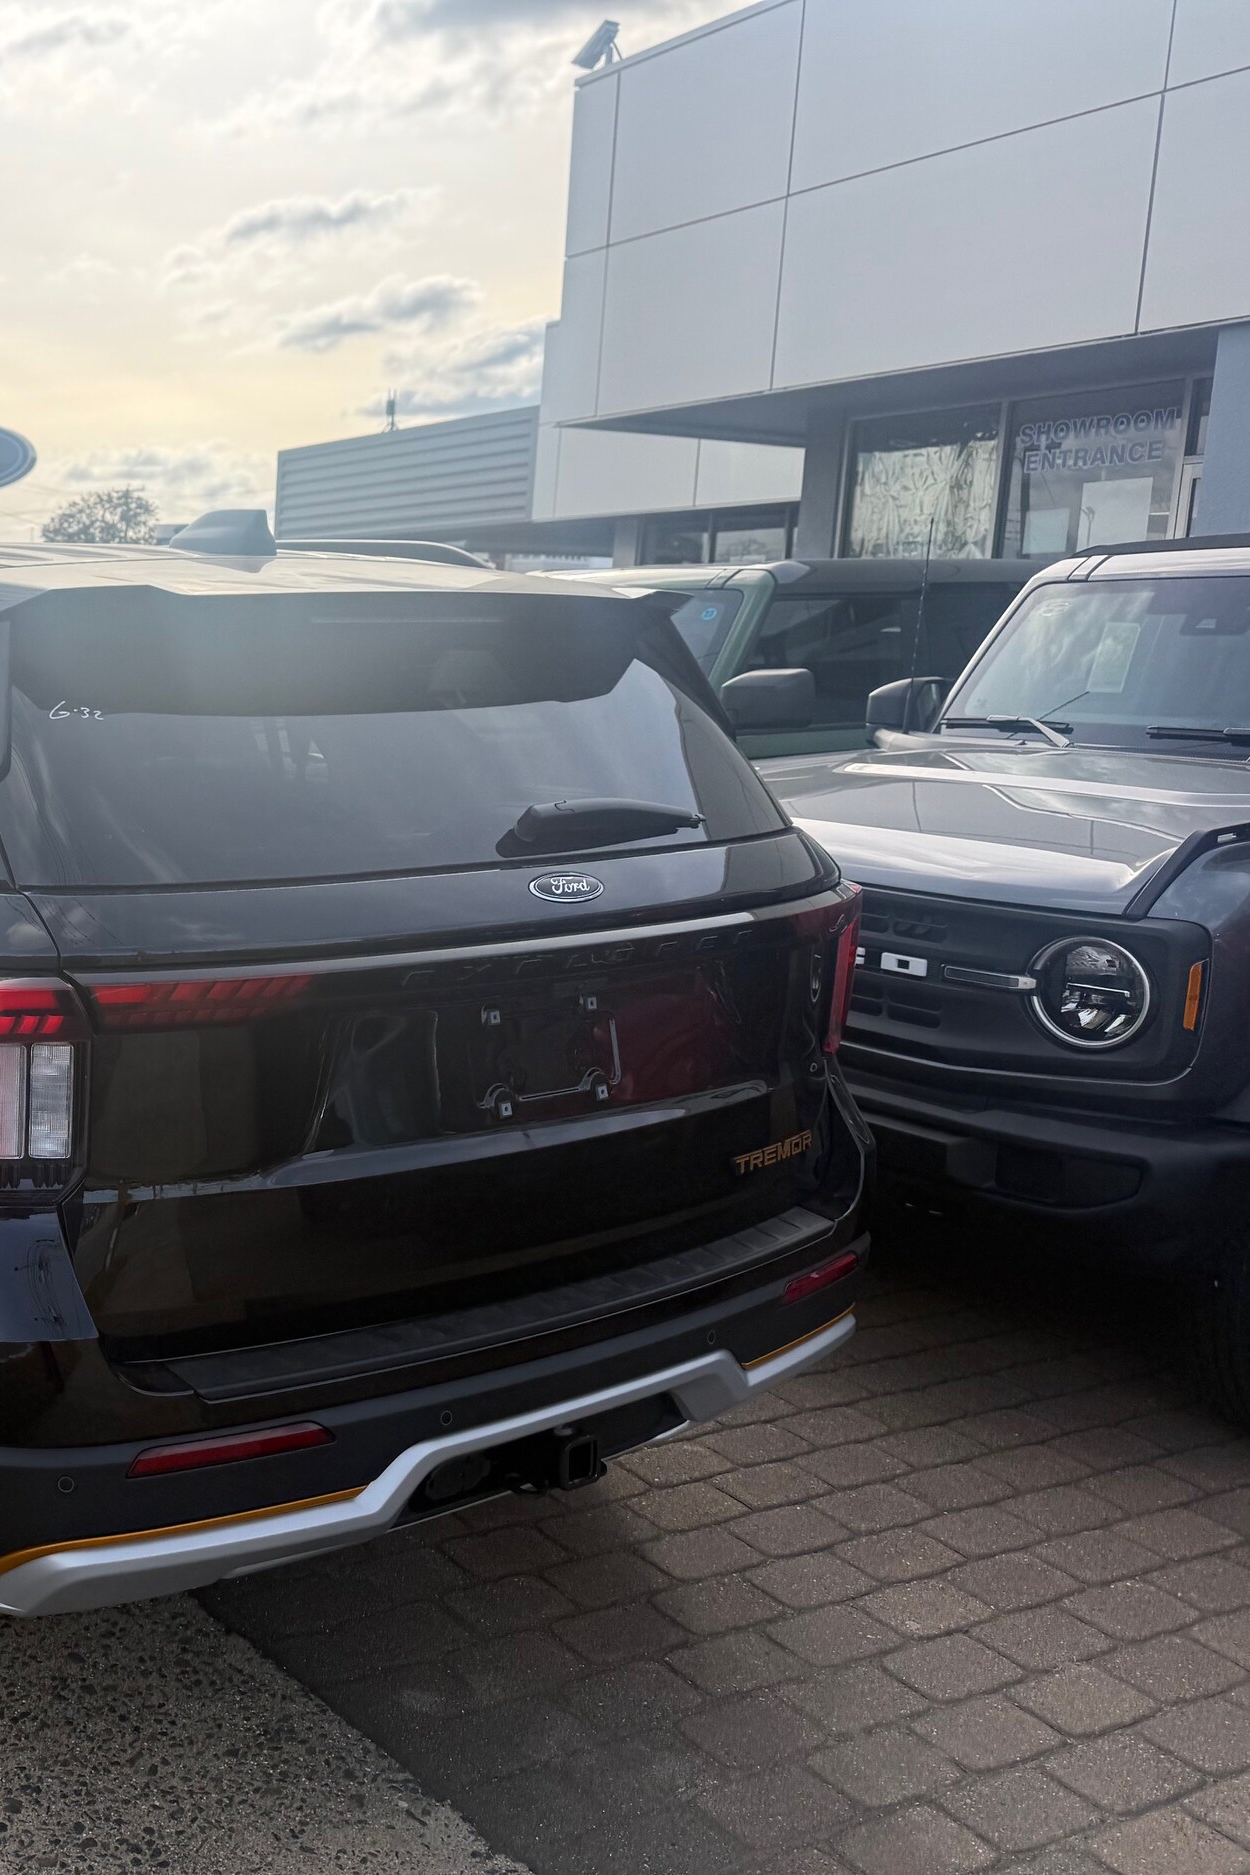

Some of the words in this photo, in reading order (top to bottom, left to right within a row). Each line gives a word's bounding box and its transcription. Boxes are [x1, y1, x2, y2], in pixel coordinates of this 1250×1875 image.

[1019, 407, 1177, 446] SHOWROOM
[1024, 439, 1164, 473] ENTRANCE
[550, 876, 590, 895] Ford
[734, 1129, 812, 1175] TREMOR
